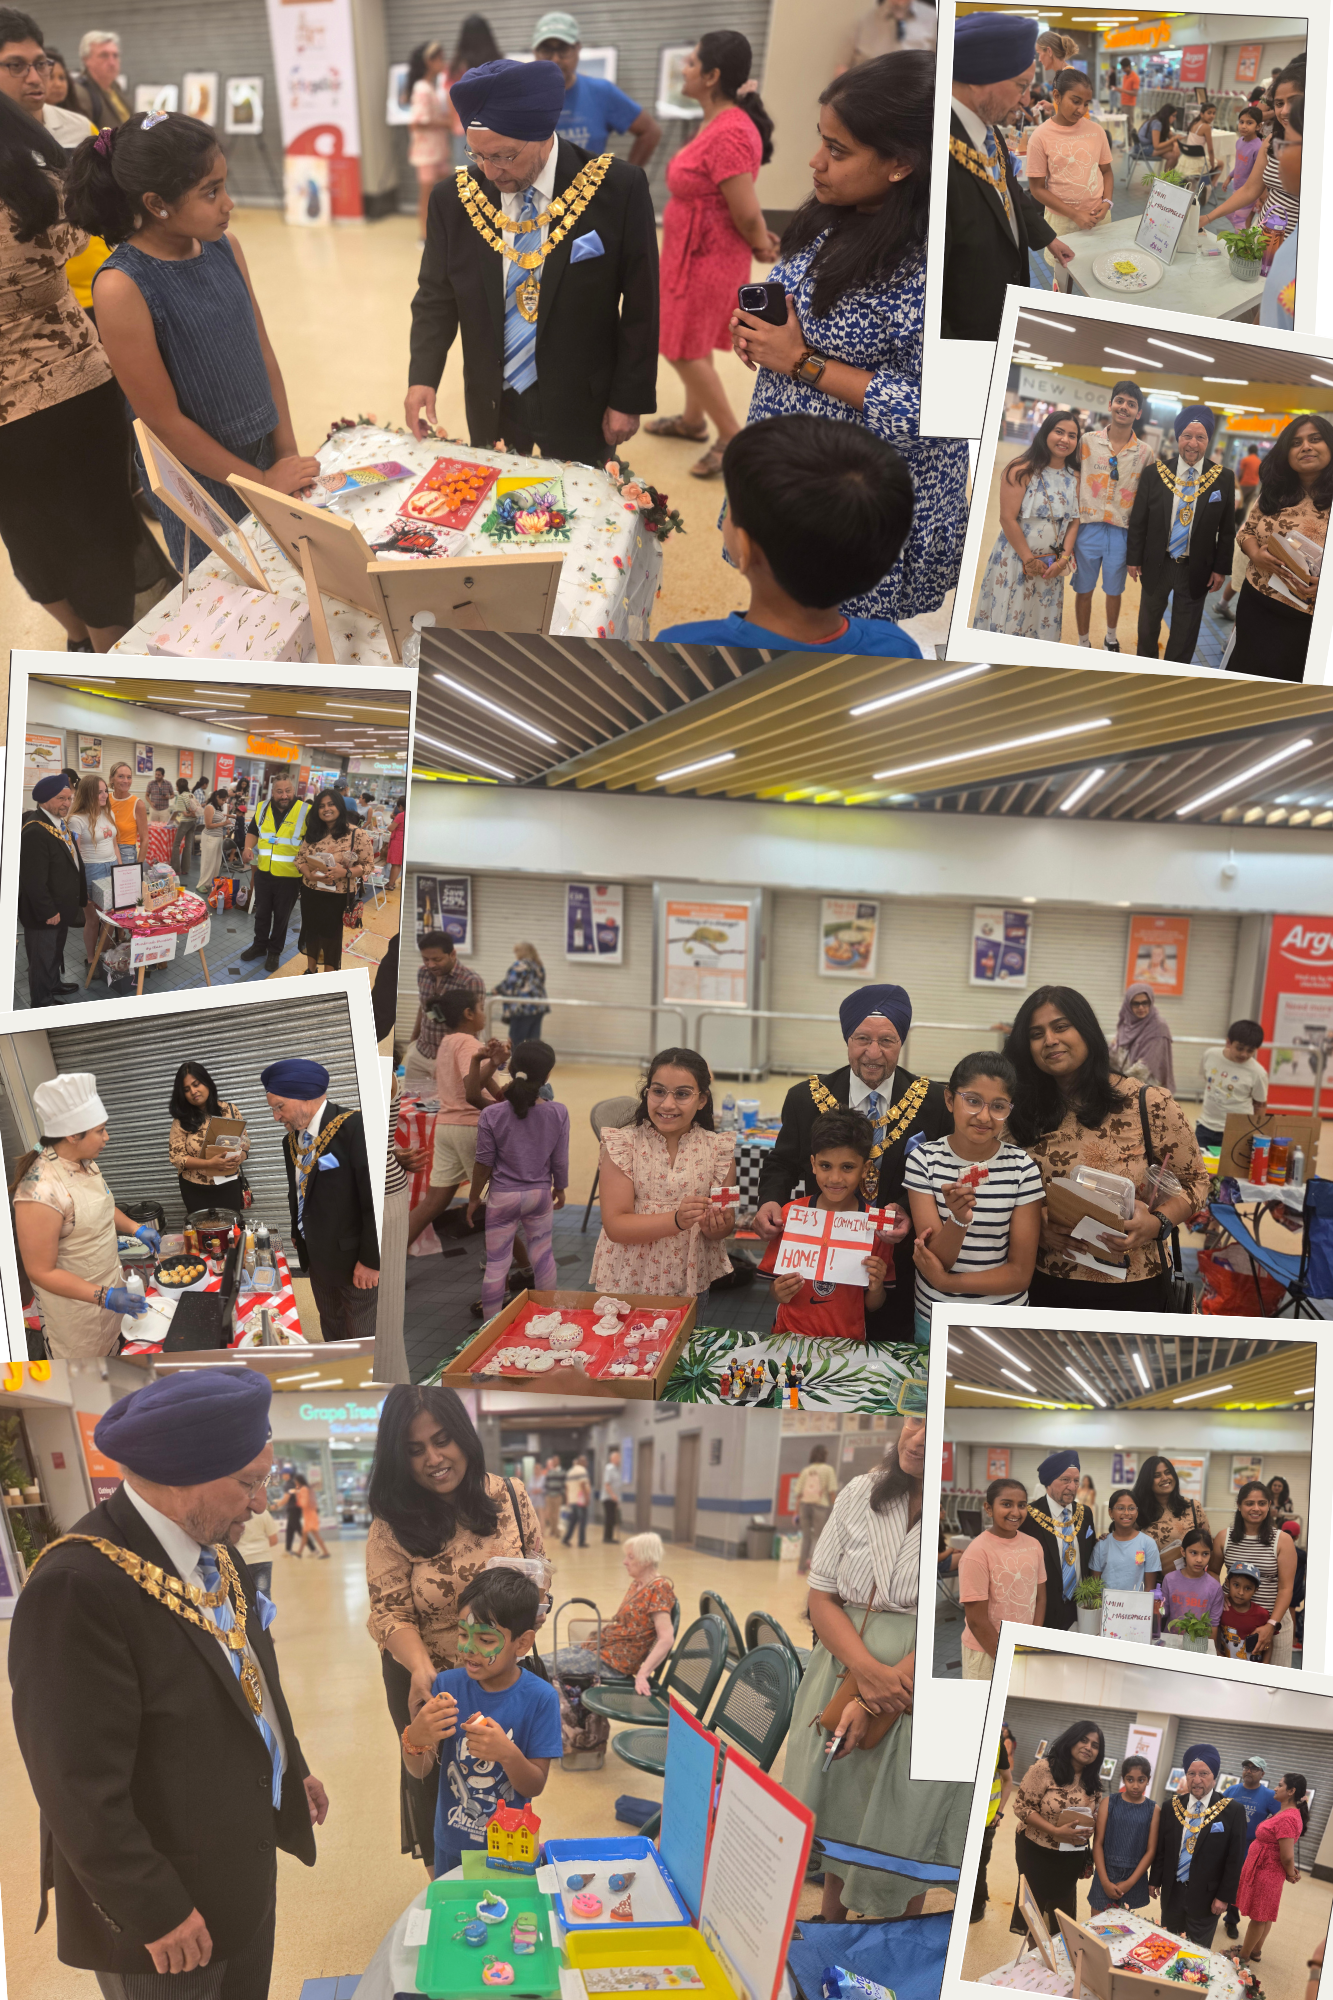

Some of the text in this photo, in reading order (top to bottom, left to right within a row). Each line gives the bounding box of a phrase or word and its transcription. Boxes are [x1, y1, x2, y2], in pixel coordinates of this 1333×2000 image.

[1103, 20, 1171, 48] Sainsbury's
[1185, 53, 1204, 64] Argos
[1022, 377, 1107, 405] NEW LOO
[246, 735, 300, 763] Sainsbury's
[218, 756, 234, 767] Argos
[374, 762, 403, 770] Grape Tree
[442, 896, 465, 906] 25%
[444, 888, 465, 896] Save
[781, 1248, 835, 1271] HOME !
[299, 1402, 377, 1423] Grape Tree
[447, 1804, 487, 1832] AVEN
